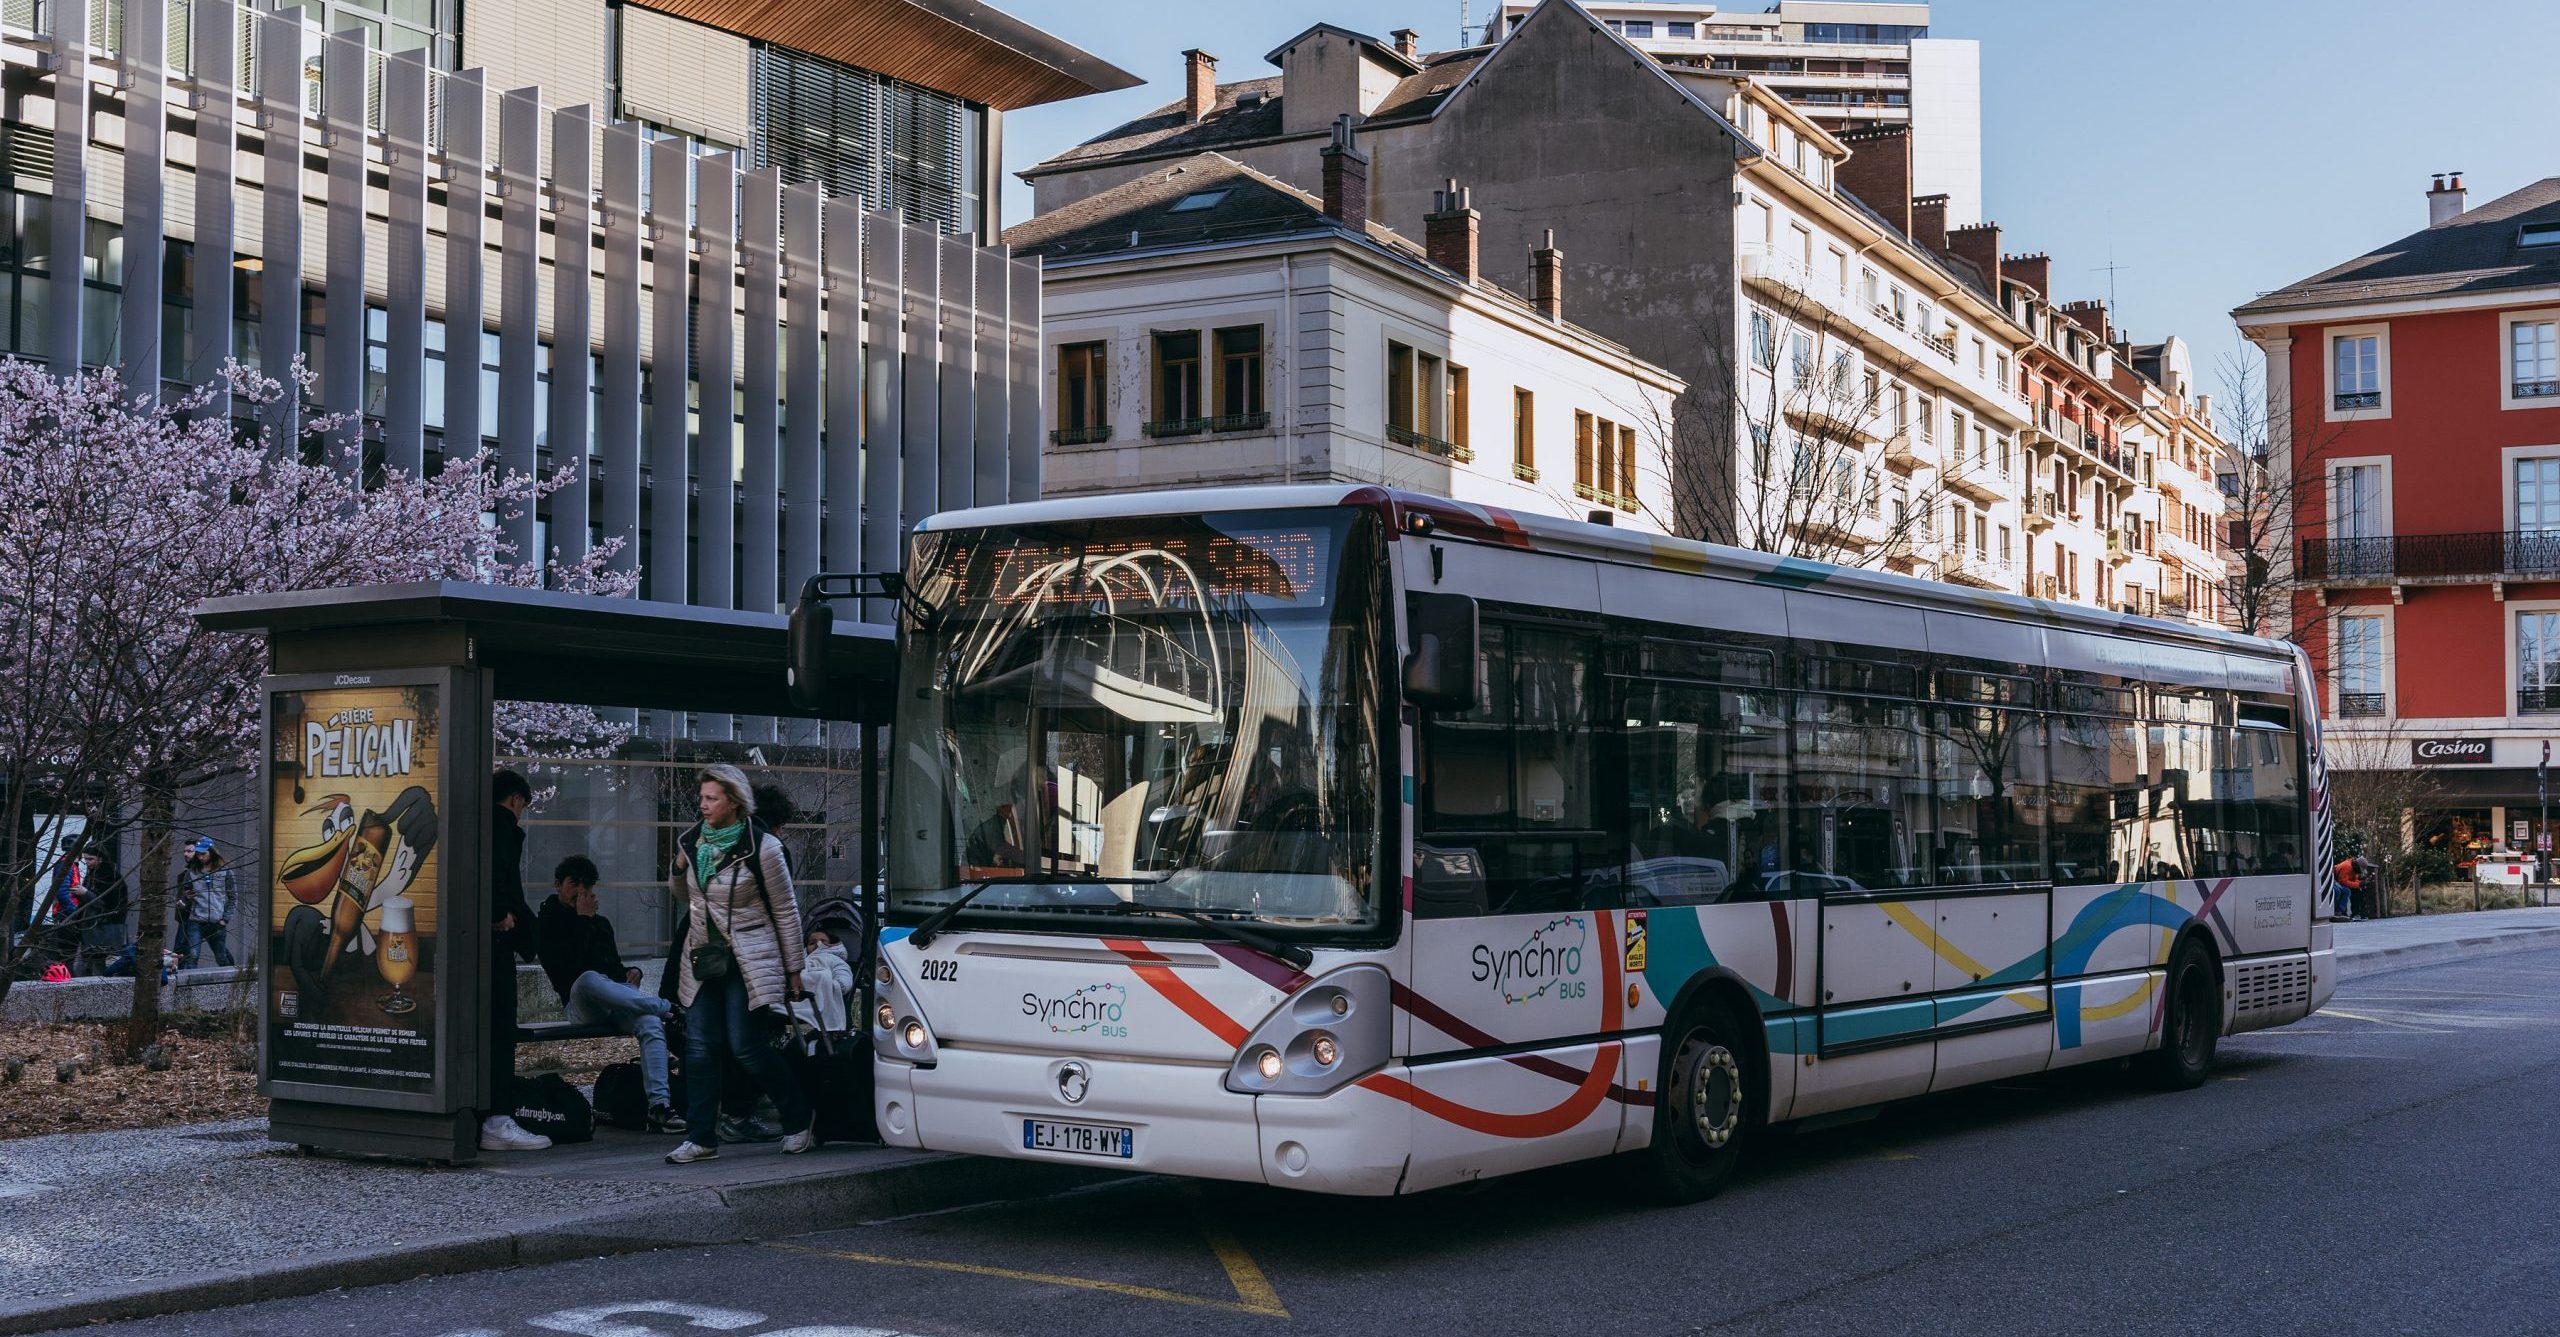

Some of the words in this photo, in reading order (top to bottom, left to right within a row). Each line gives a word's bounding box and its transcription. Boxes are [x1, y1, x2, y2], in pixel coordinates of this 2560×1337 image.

[333, 674, 371, 686] JCDecaux
[340, 707, 374, 726] BIÈRE
[2417, 740, 2486, 758] Casino
[920, 959, 958, 982] 2022
[1471, 941, 1581, 991] Synchro
[1560, 981, 1586, 999] BUS
[1022, 992, 1122, 1022] Synchro
[1101, 1025, 1128, 1038] BUS
[1122, 1144, 1131, 1154] 73
